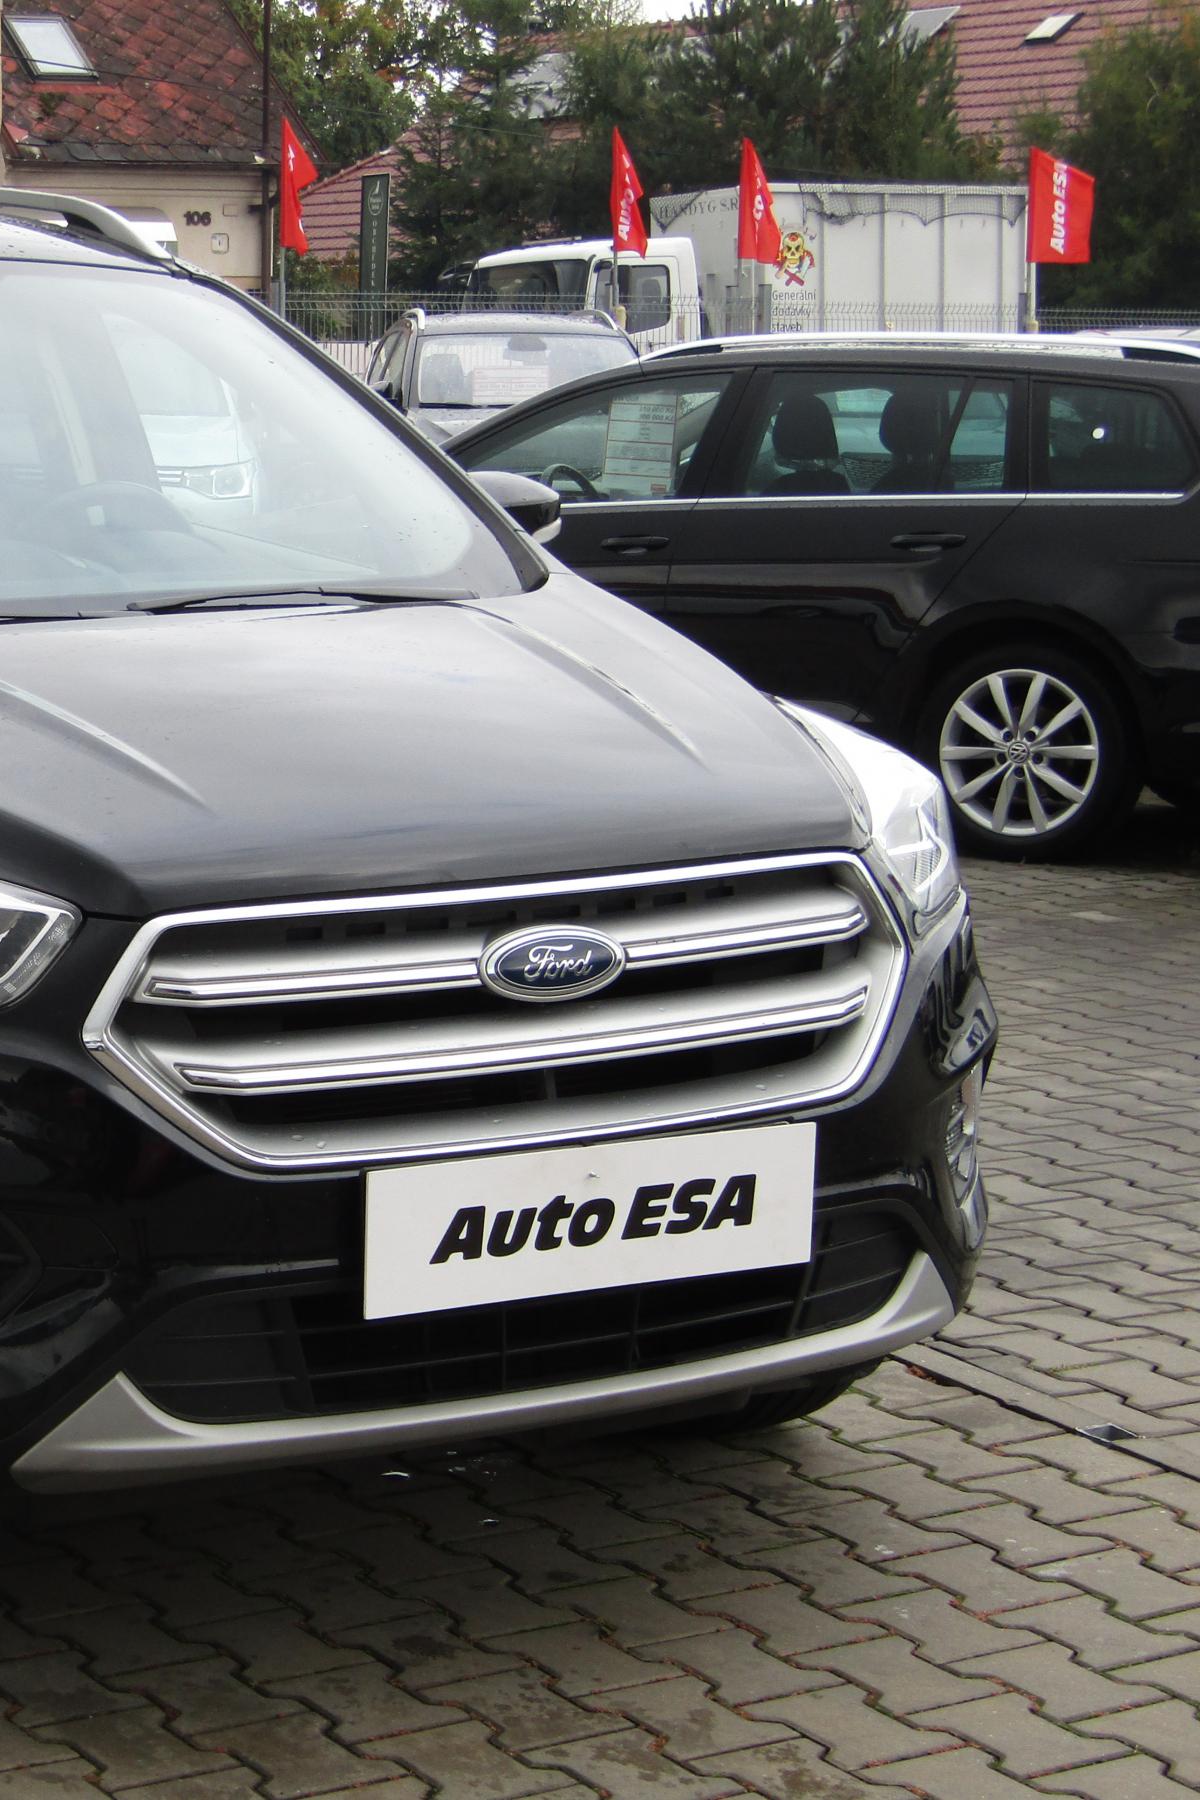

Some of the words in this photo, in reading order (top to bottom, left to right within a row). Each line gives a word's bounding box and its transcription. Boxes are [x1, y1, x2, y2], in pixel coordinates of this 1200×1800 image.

[1050, 199, 1066, 255] Auto
[772, 289, 816, 301] Generální
[772, 305, 811, 318] dodávky
[772, 321, 802, 332] staveb
[523, 943, 593, 981] Ford
[428, 1194, 616, 1265] Auto
[620, 1173, 757, 1241] ESA
